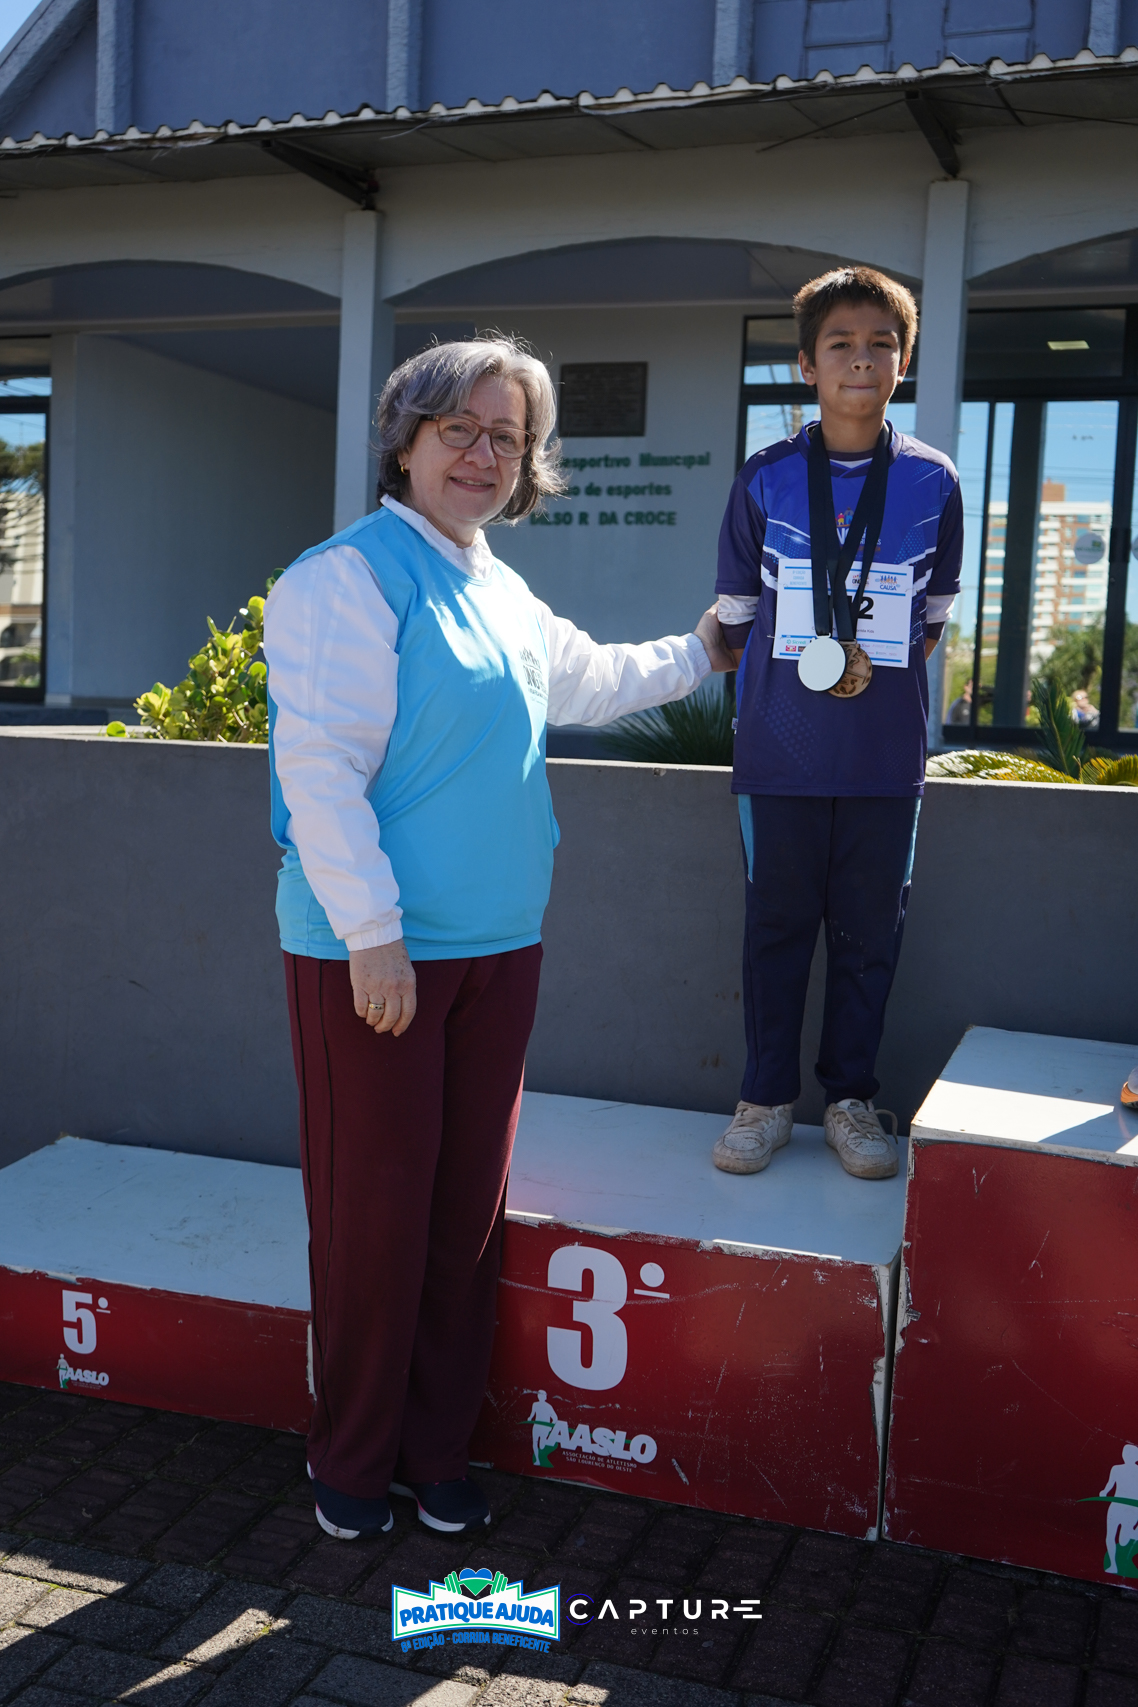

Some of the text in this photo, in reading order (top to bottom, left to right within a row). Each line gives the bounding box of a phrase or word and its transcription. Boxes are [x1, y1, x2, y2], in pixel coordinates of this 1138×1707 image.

[560, 452, 711, 472] esportivo Municipal
[584, 482, 602, 496] de
[606, 482, 672, 499] esportes
[598, 511, 619, 525] DA
[624, 511, 677, 525] CROCE
[65, 1367, 109, 1386] AASLO
[546, 1420, 657, 1464] AASLO
[562, 1450, 596, 1460] ASSOCIAÇÃO
[606, 1458, 637, 1469] ATLETISMO
[578, 1458, 605, 1468] LOURENÇO
